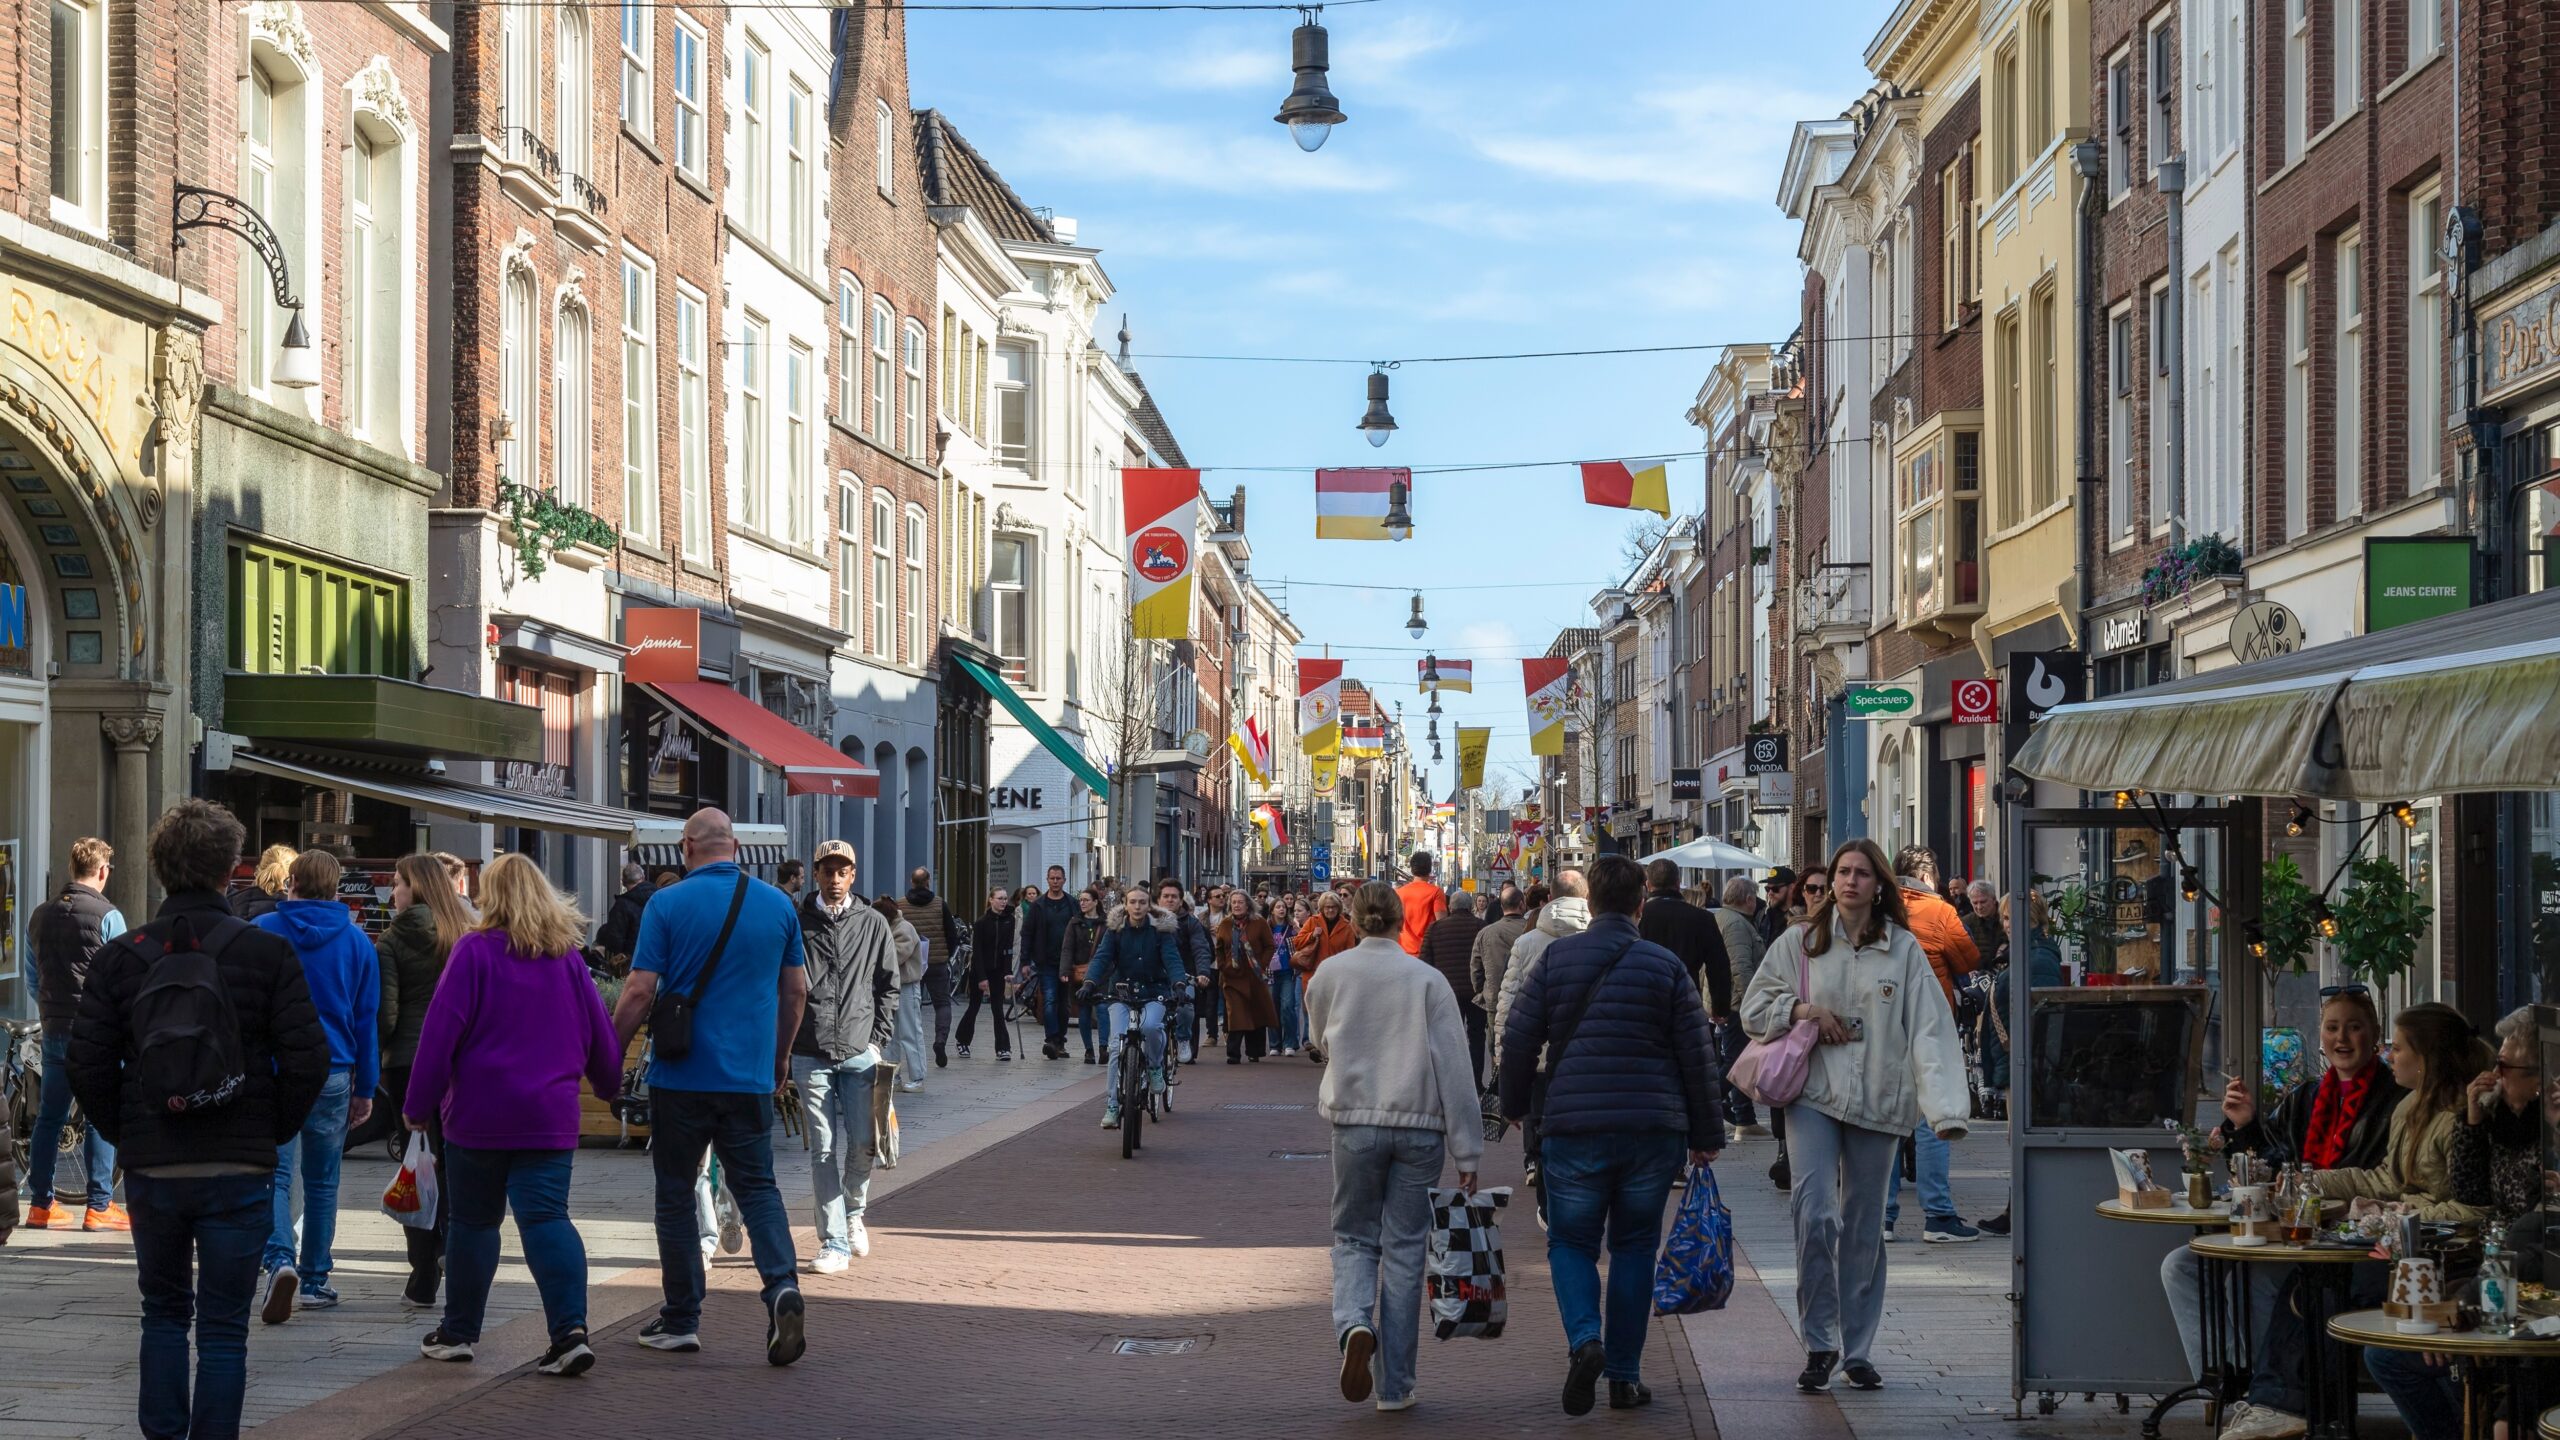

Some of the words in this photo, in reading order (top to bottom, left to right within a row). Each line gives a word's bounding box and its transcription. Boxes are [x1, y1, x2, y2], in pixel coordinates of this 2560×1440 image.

[9, 287, 119, 451] ROYAL
[2383, 586, 2416, 597] JEANS
[2418, 586, 2457, 597] CENTRE
[2109, 609, 2141, 650] Burned
[2250, 606, 2287, 637] WO
[630, 635, 693, 656] jamin
[1855, 695, 1909, 706] Specsavers
[1958, 714, 1992, 723] Kruidvat
[1749, 763, 1784, 772] OMODA
